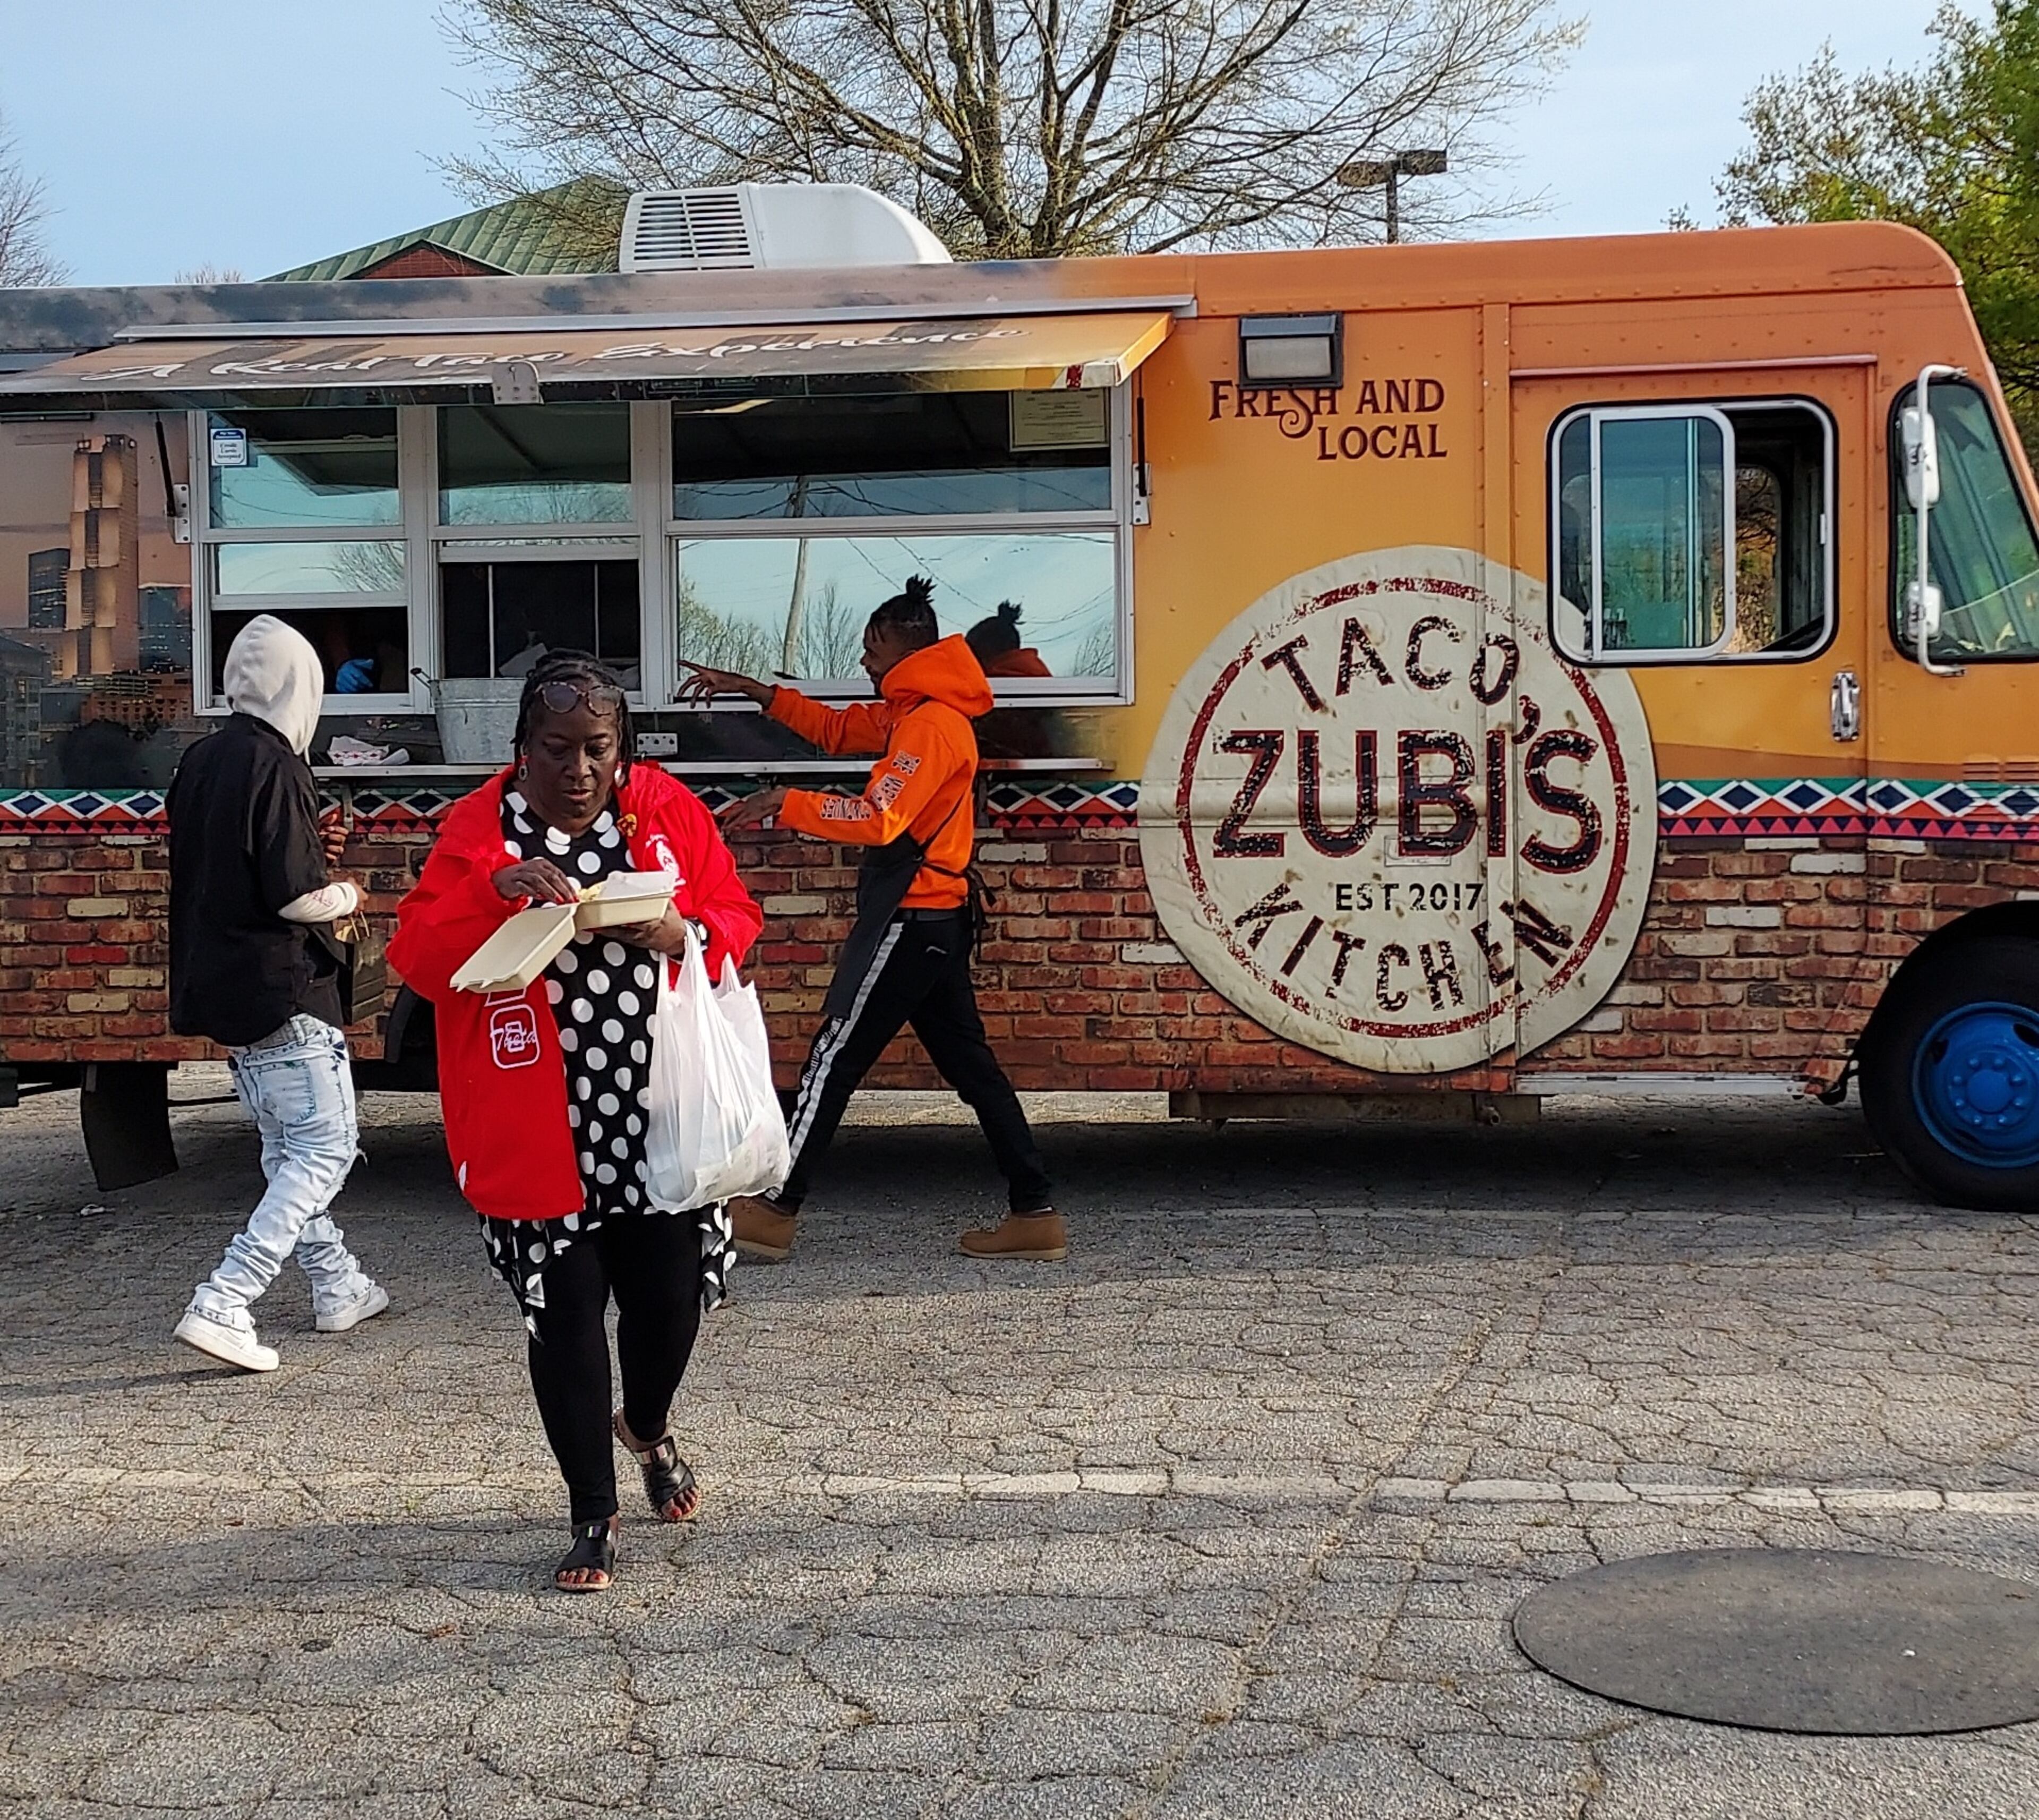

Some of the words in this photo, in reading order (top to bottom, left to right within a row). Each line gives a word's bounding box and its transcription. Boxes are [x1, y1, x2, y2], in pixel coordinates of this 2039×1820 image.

[81, 363, 186, 380] A
[210, 357, 389, 374] Real
[388, 352, 565, 367] Taco
[593, 330, 1031, 358] Experience
[1209, 380, 1338, 439] FRESH
[1356, 379, 1445, 414] AND
[1317, 424, 1447, 460] LOCAL
[1262, 616, 1520, 712] TACO
[1213, 695, 1603, 874] ZUBI'S
[1408, 883, 1484, 911] 2017
[1234, 883, 1574, 1013] KITCHEN
